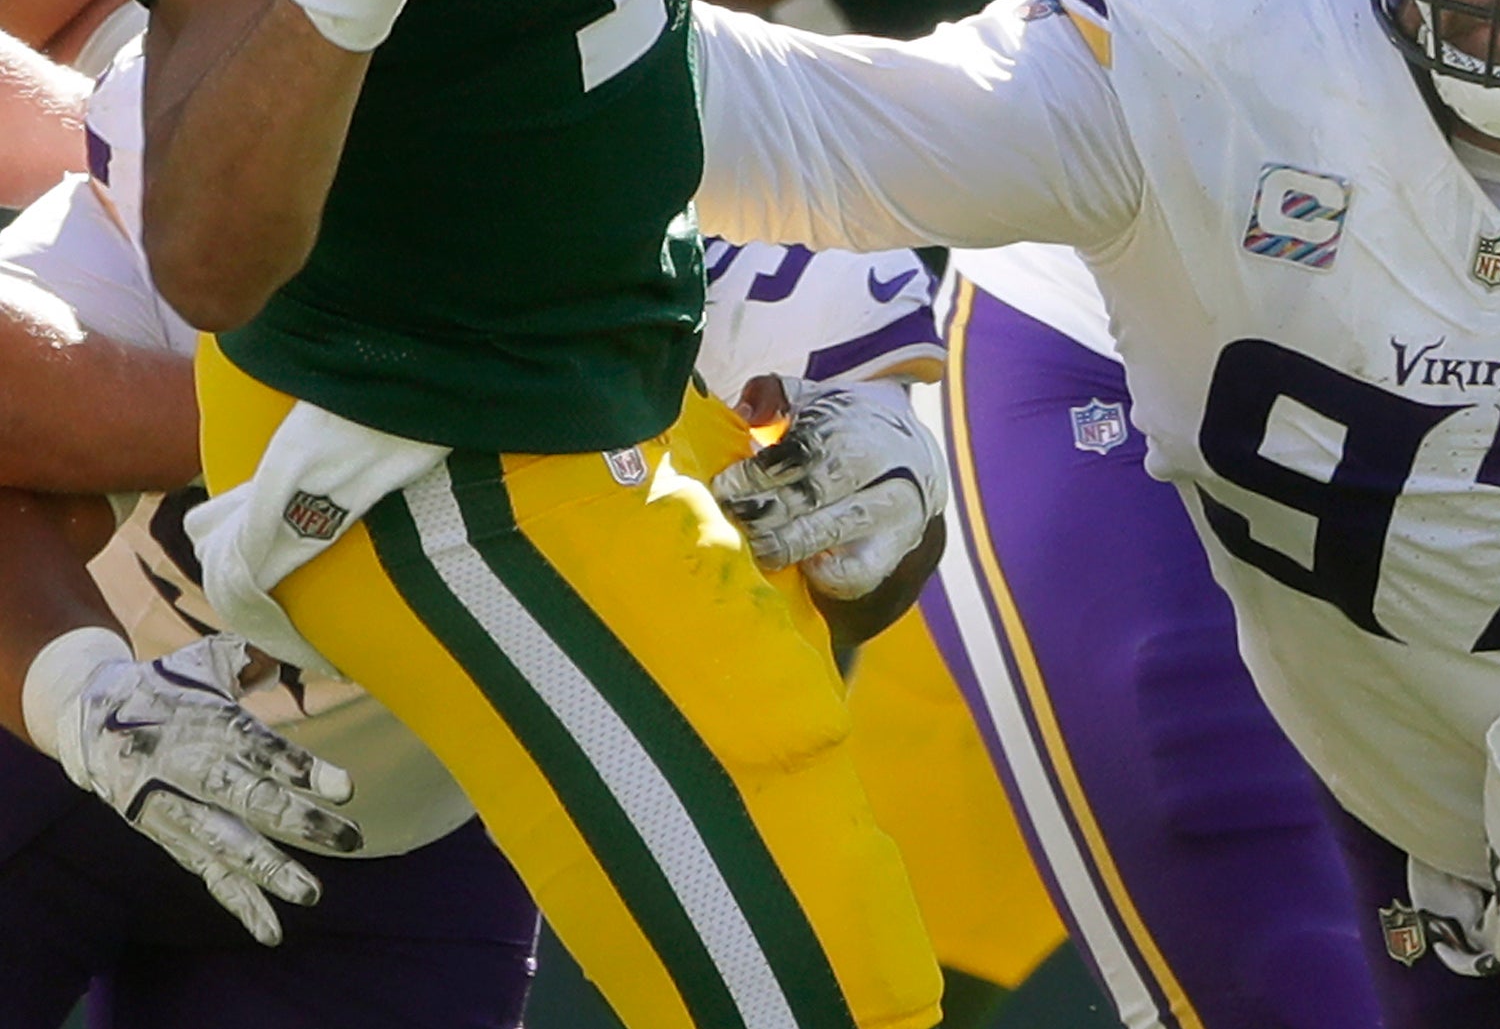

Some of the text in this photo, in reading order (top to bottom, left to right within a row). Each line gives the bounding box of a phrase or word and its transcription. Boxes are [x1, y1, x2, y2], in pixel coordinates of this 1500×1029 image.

[1258, 168, 1345, 244] C
[1082, 421, 1120, 443] NFL
[286, 502, 332, 535] NFL
